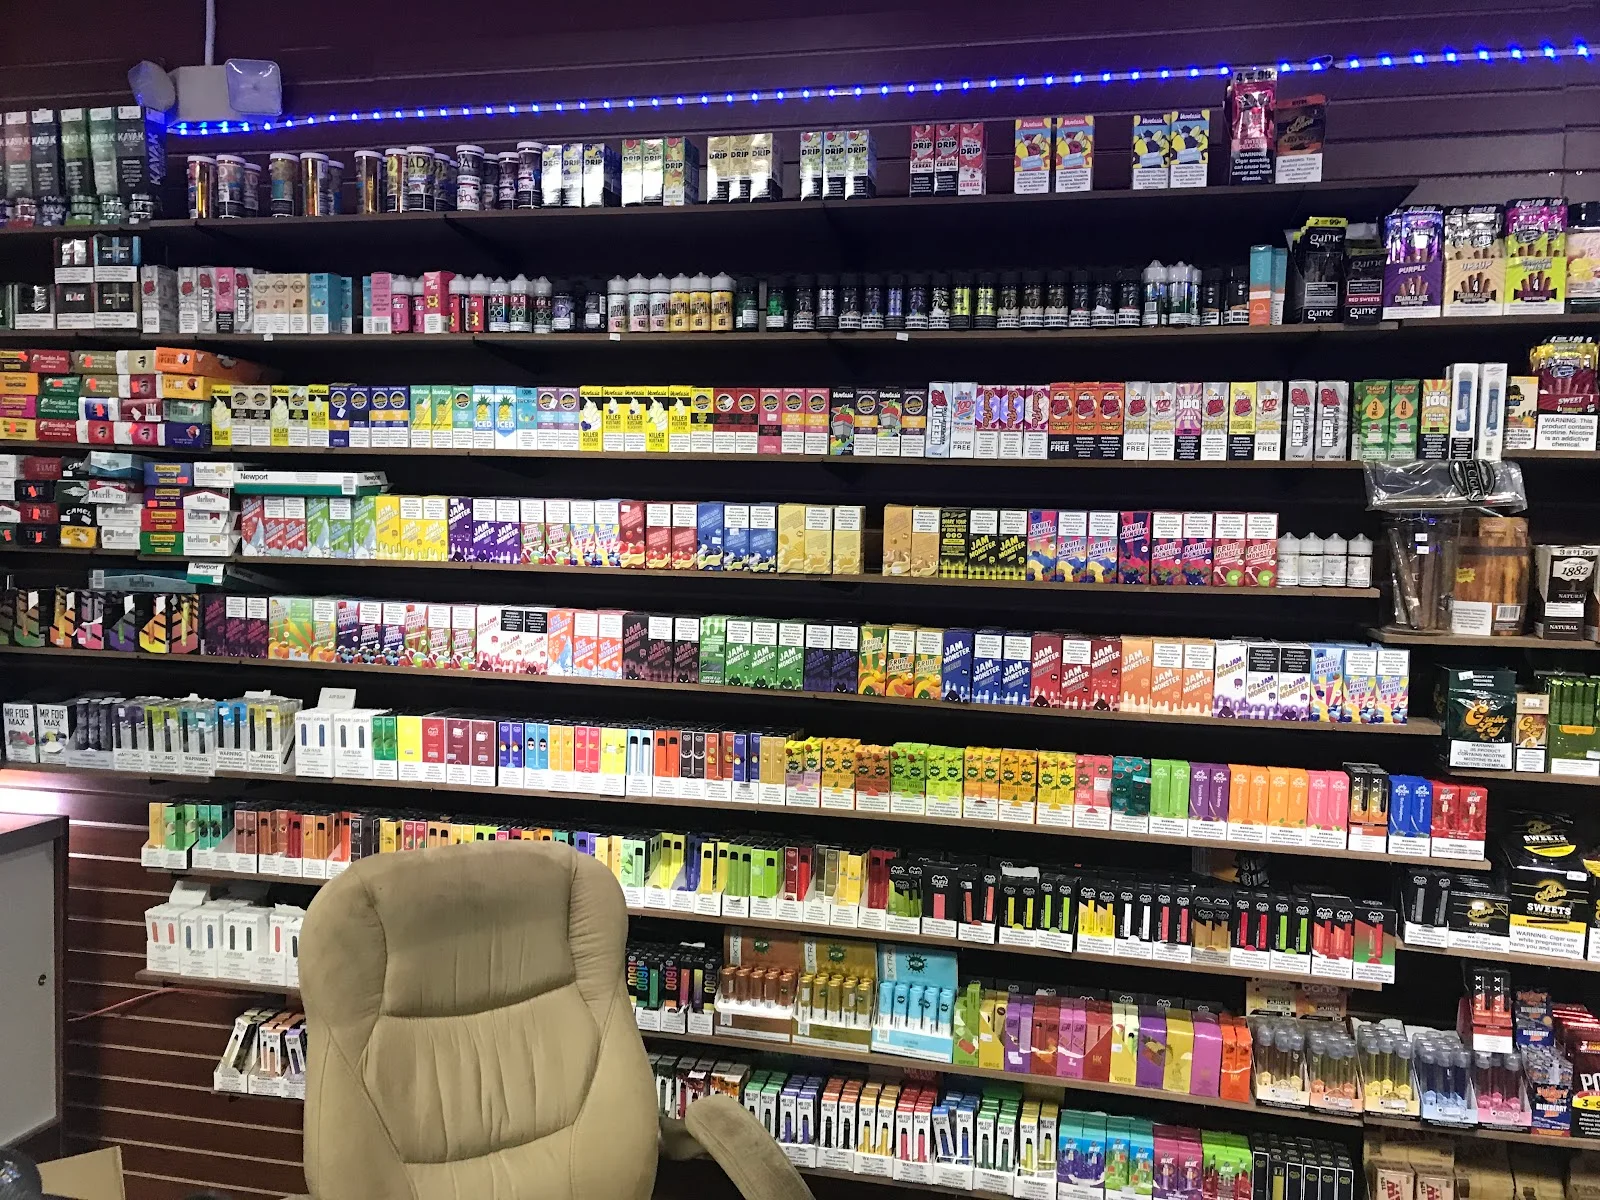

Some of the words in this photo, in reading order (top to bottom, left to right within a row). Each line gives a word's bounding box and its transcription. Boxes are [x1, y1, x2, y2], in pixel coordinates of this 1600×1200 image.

[32, 136, 56, 145] KAYAK
[117, 132, 143, 141] KAYAK
[149, 134, 161, 185] KAYAK
[585, 158, 602, 166] DRIP
[665, 162, 683, 170] DRIP
[1310, 234, 1343, 248] game
[1352, 259, 1383, 271] game
[1399, 265, 1426, 274] PURPLE
[1410, 284, 1415, 294] 4
[1473, 280, 1478, 291] 4
[1533, 279, 1538, 291] 4
[1308, 309, 1334, 321] game
[1350, 308, 1377, 319] game
[1179, 400, 1199, 409] 100
[1373, 402, 1378, 410] 3
[1402, 401, 1406, 410] 0
[1426, 396, 1447, 407] 100
[474, 420, 492, 428] ICED
[1292, 419, 1304, 447] KEEP
[1321, 419, 1333, 447] KEEP
[36, 464, 57, 472] TIME
[240, 473, 268, 481] Newport
[22, 486, 44, 495] TME
[92, 489, 123, 498] Marlbro
[27, 509, 51, 518] TME
[66, 508, 91, 516] CAMEL
[1029, 526, 1056, 537] MONSTER
[1031, 521, 1051, 531] FRUIT
[1123, 522, 1143, 533] FRUIT
[1120, 528, 1148, 538] MONSTER
[1088, 545, 1116, 556] MONSTER
[1089, 541, 1110, 550] FRUIT
[1152, 543, 1176, 554] FRUIT
[1562, 566, 1588, 576] 1882
[945, 641, 963, 655] JAM
[1033, 647, 1052, 660] JAM
[1093, 646, 1113, 660] JAM
[943, 647, 970, 664] MONSTER
[1032, 652, 1059, 669] MONSTER
[1091, 652, 1120, 669] MONSTER
[1123, 650, 1143, 664] JAM
[1316, 656, 1336, 664] FROZEN
[975, 660, 993, 674] JAM
[1004, 661, 1022, 675] JAM
[1122, 656, 1150, 673] MONSTER
[973, 666, 1000, 682] MONSTER
[1002, 667, 1029, 684] MONSTER
[1063, 666, 1082, 679] JAM
[1153, 670, 1173, 683] JAM
[1185, 671, 1204, 684] JAM
[1062, 671, 1089, 688] MONSTER
[1152, 675, 1180, 692] MONSTER
[1183, 676, 1212, 694] MONSTER
[4, 709, 13, 718] MR
[15, 709, 29, 718] FOG
[40, 709, 48, 718] MR
[50, 709, 64, 718] FOG
[9, 718, 25, 726] MAX
[1527, 903, 1571, 915] SWEETS
[637, 965, 648, 990] 1600
[666, 966, 677, 990] 1600
[704, 969, 716, 993] 1600
[1302, 983, 1338, 993] bang
[1580, 1041, 1587, 1050] 3
[1536, 1103, 1567, 1112] BLUEBERRY
[1583, 1098, 1588, 1106] 3
[1490, 1109, 1520, 1121] bang
